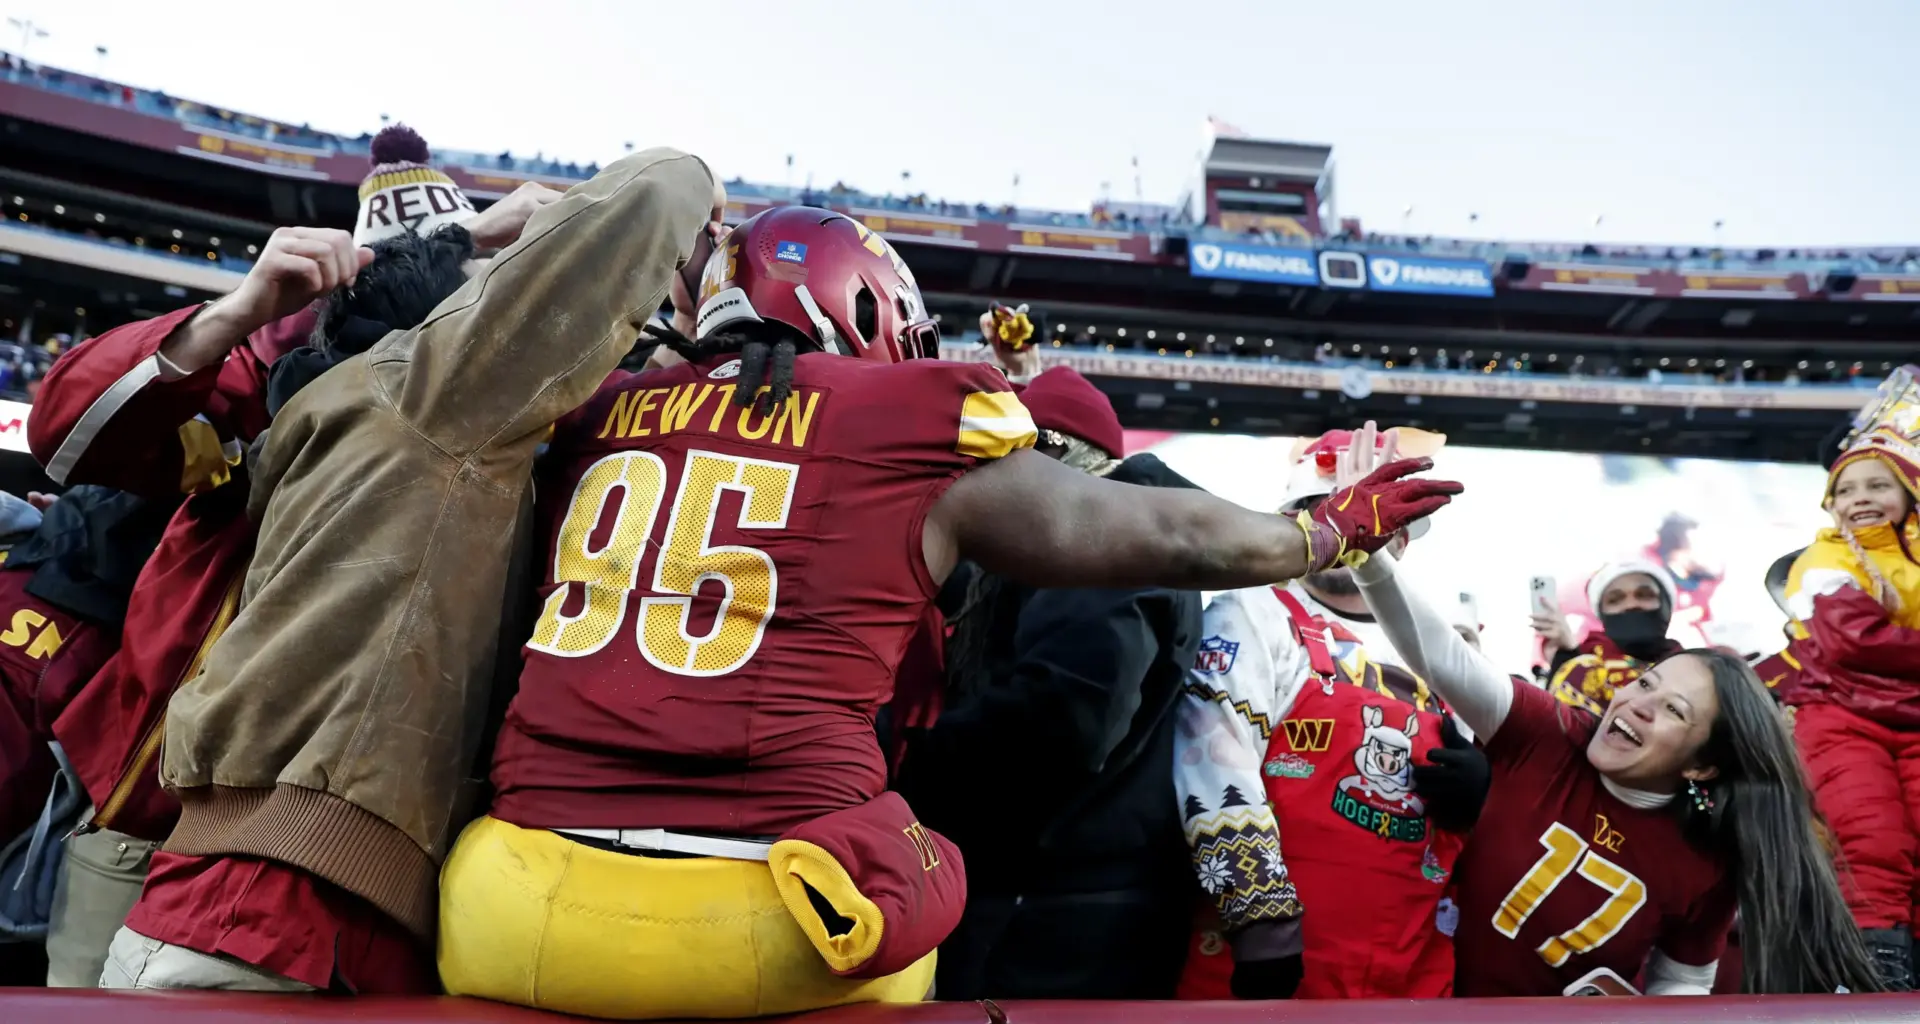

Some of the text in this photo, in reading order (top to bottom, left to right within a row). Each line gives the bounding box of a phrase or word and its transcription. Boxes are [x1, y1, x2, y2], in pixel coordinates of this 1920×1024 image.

[1224, 252, 1315, 277] FANDUEL
[1401, 265, 1491, 289] FANDUEL
[1146, 361, 1325, 388] CHAMPIONS
[597, 383, 820, 447] NEWTON
[525, 449, 800, 677] 95
[1194, 650, 1228, 671] NFL
[1332, 788, 1369, 826] HOG
[1491, 821, 1647, 968] 17
